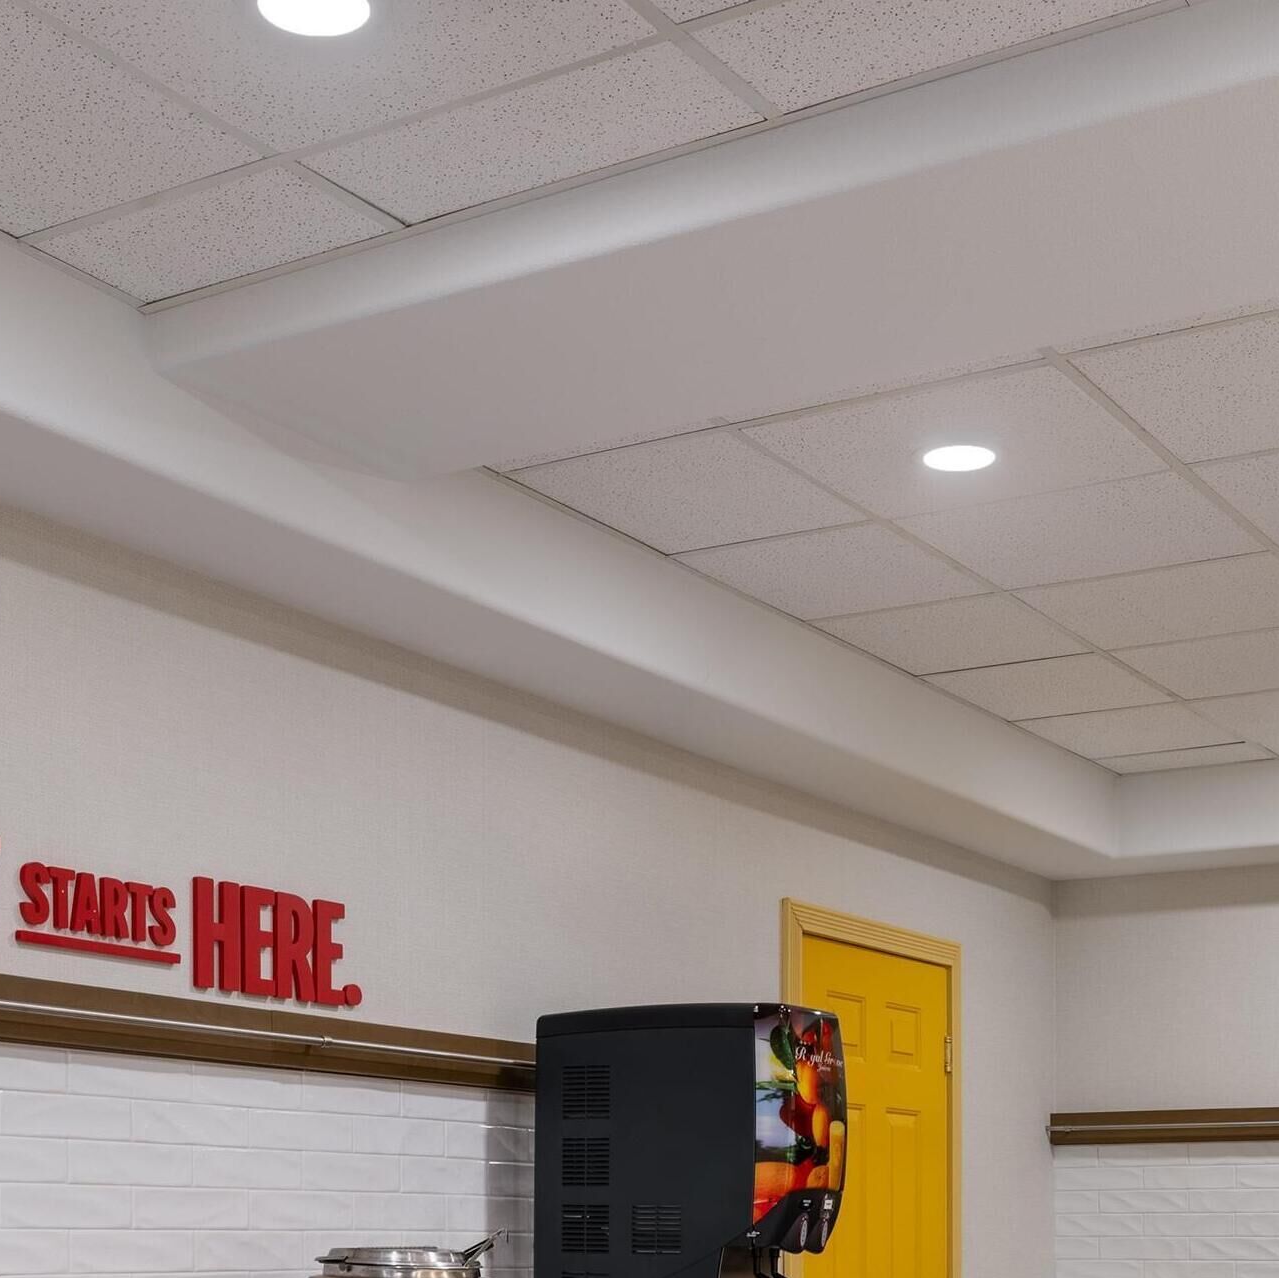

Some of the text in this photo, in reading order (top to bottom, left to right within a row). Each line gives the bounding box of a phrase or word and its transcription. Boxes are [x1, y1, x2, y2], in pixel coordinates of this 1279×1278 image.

[19, 861, 177, 946] STARTS
[192, 876, 363, 1007] HERE.
[795, 1046, 823, 1067] Ryal
